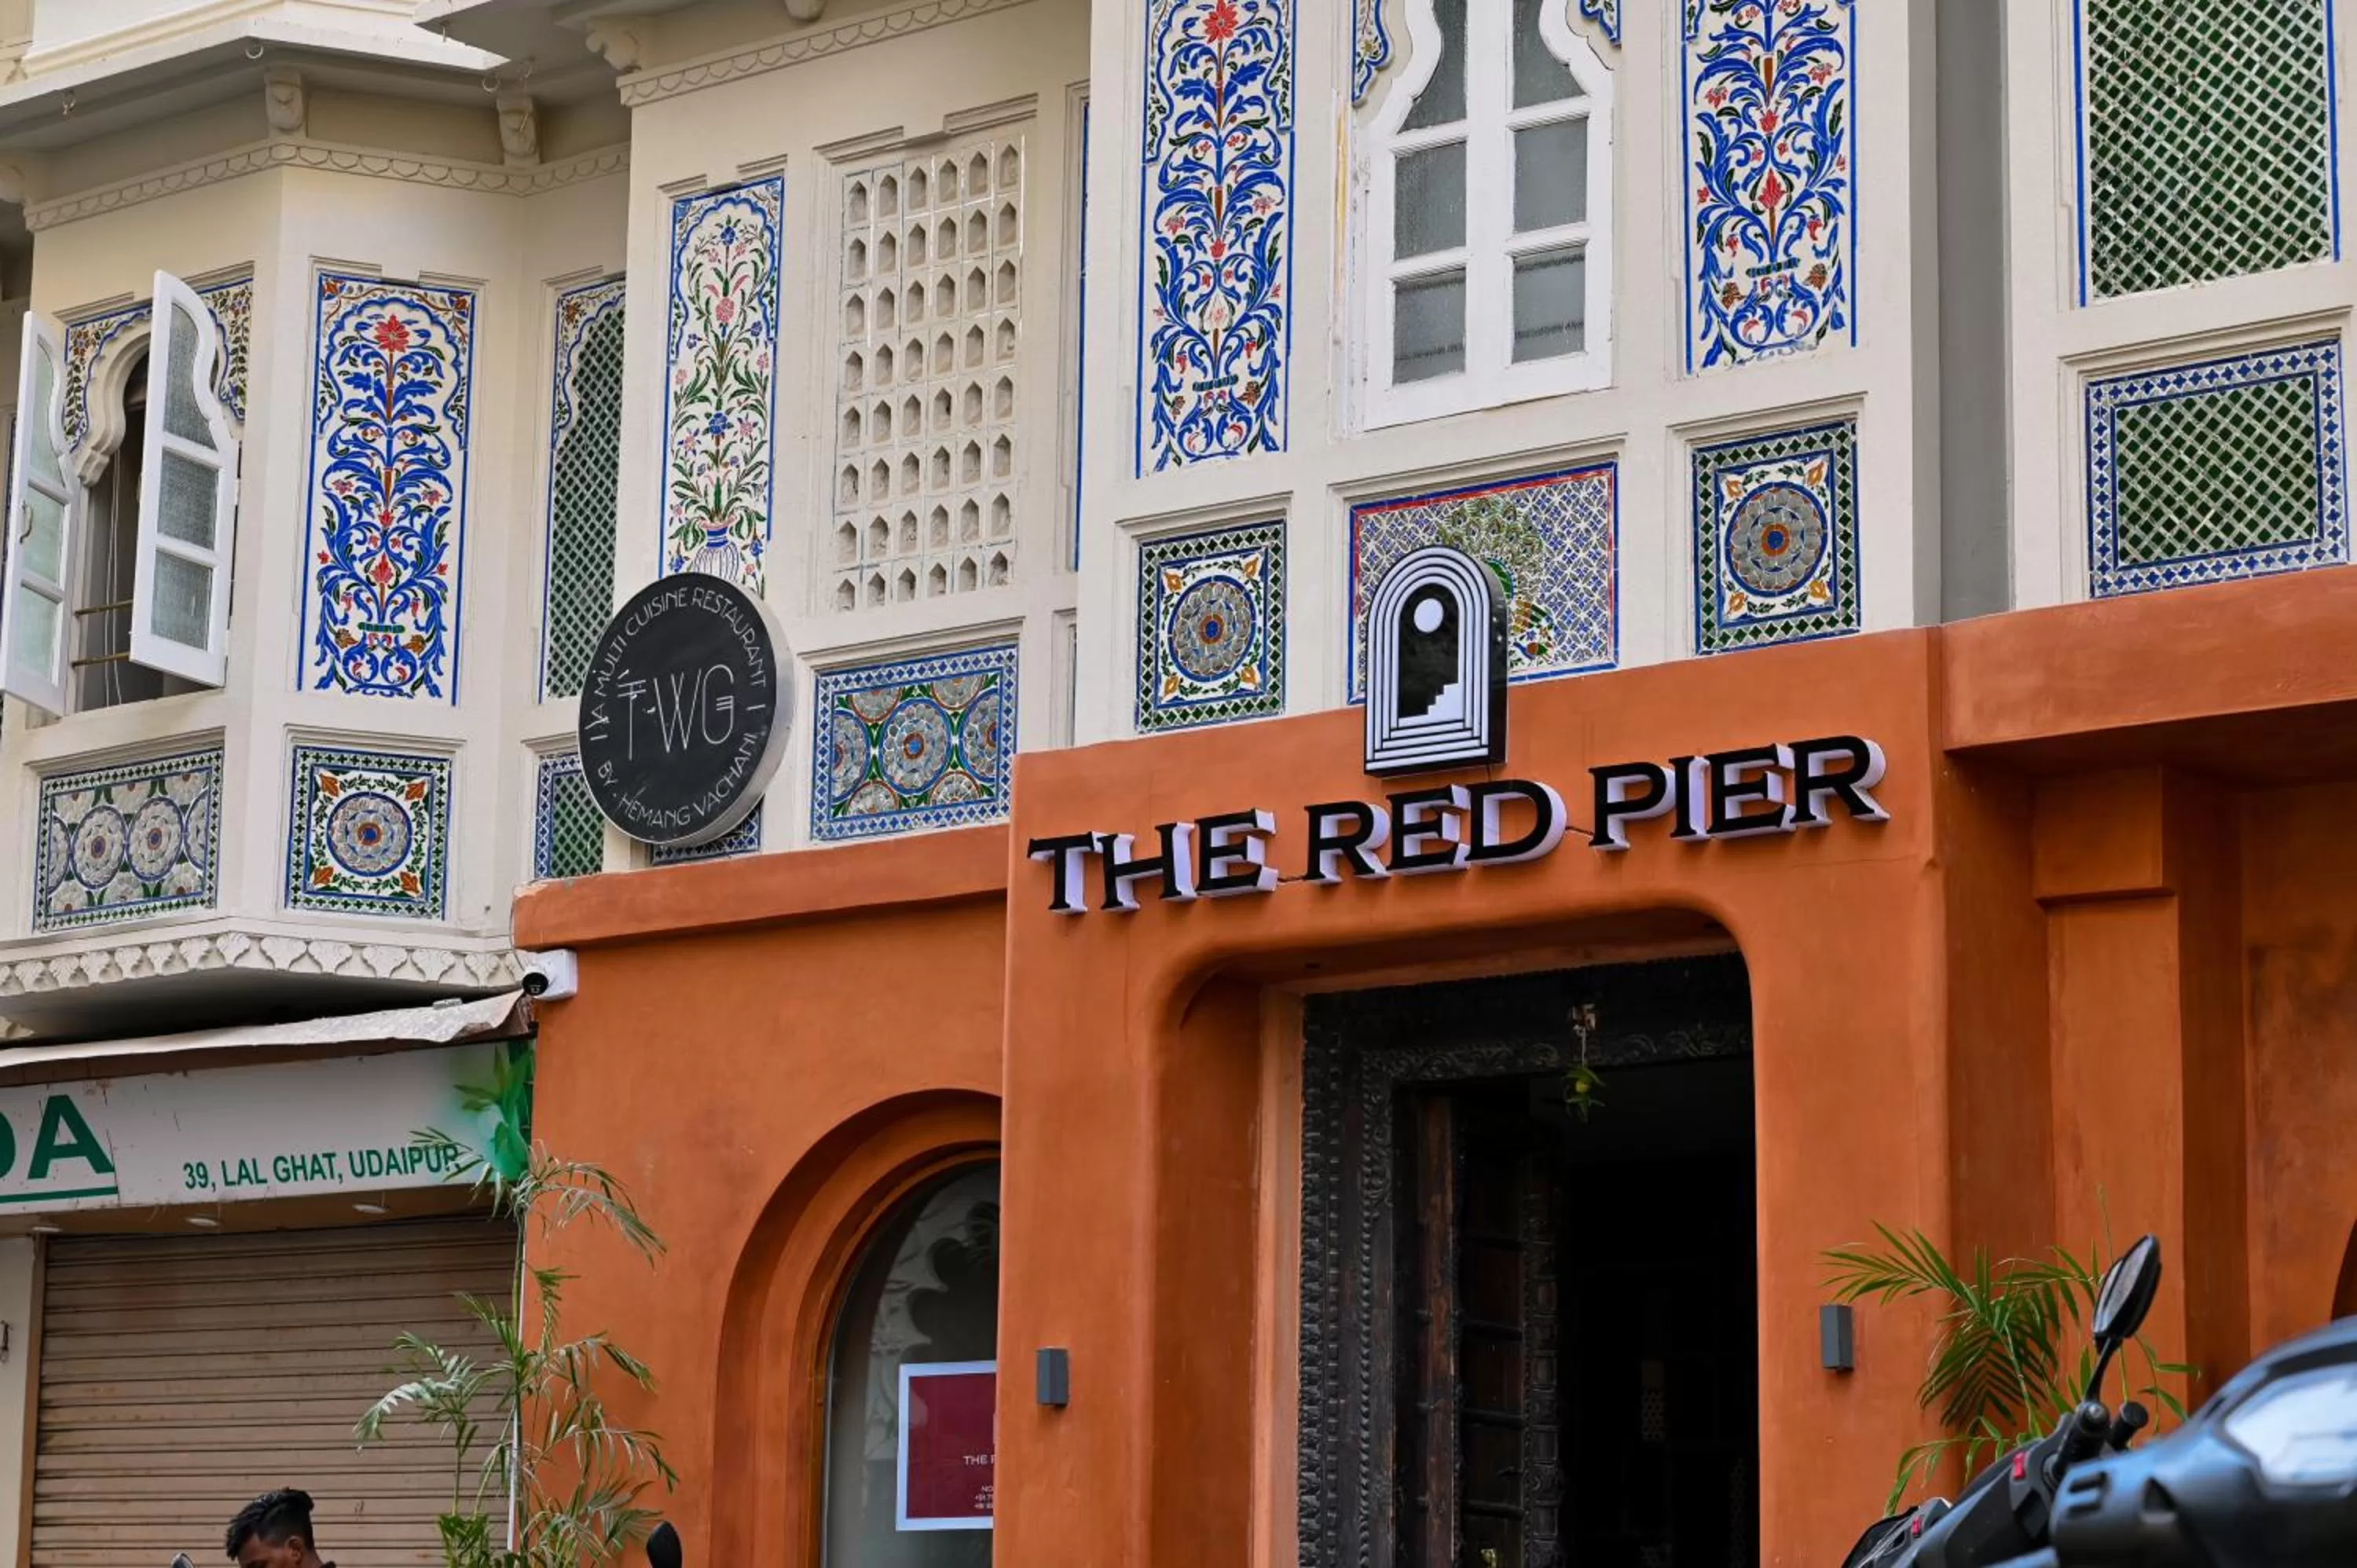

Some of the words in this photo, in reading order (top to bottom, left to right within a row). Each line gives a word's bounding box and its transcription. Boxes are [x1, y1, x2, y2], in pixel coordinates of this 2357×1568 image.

[593, 634, 628, 698] MULTI
[625, 587, 688, 636] CUISINE
[691, 587, 766, 687] RESTAURANT
[617, 664, 734, 761] TWG
[598, 760, 619, 786] BY
[614, 792, 691, 829] HEMANG
[692, 733, 758, 816] VACHANI
[1027, 808, 1278, 914] THE
[1302, 779, 1567, 885] RED
[1588, 735, 1890, 851] PIER
[0, 1094, 115, 1180] A
[183, 1162, 216, 1192] 39,
[221, 1157, 268, 1187] LAL
[273, 1151, 343, 1185] GHAT,
[962, 1454, 988, 1466] THE
